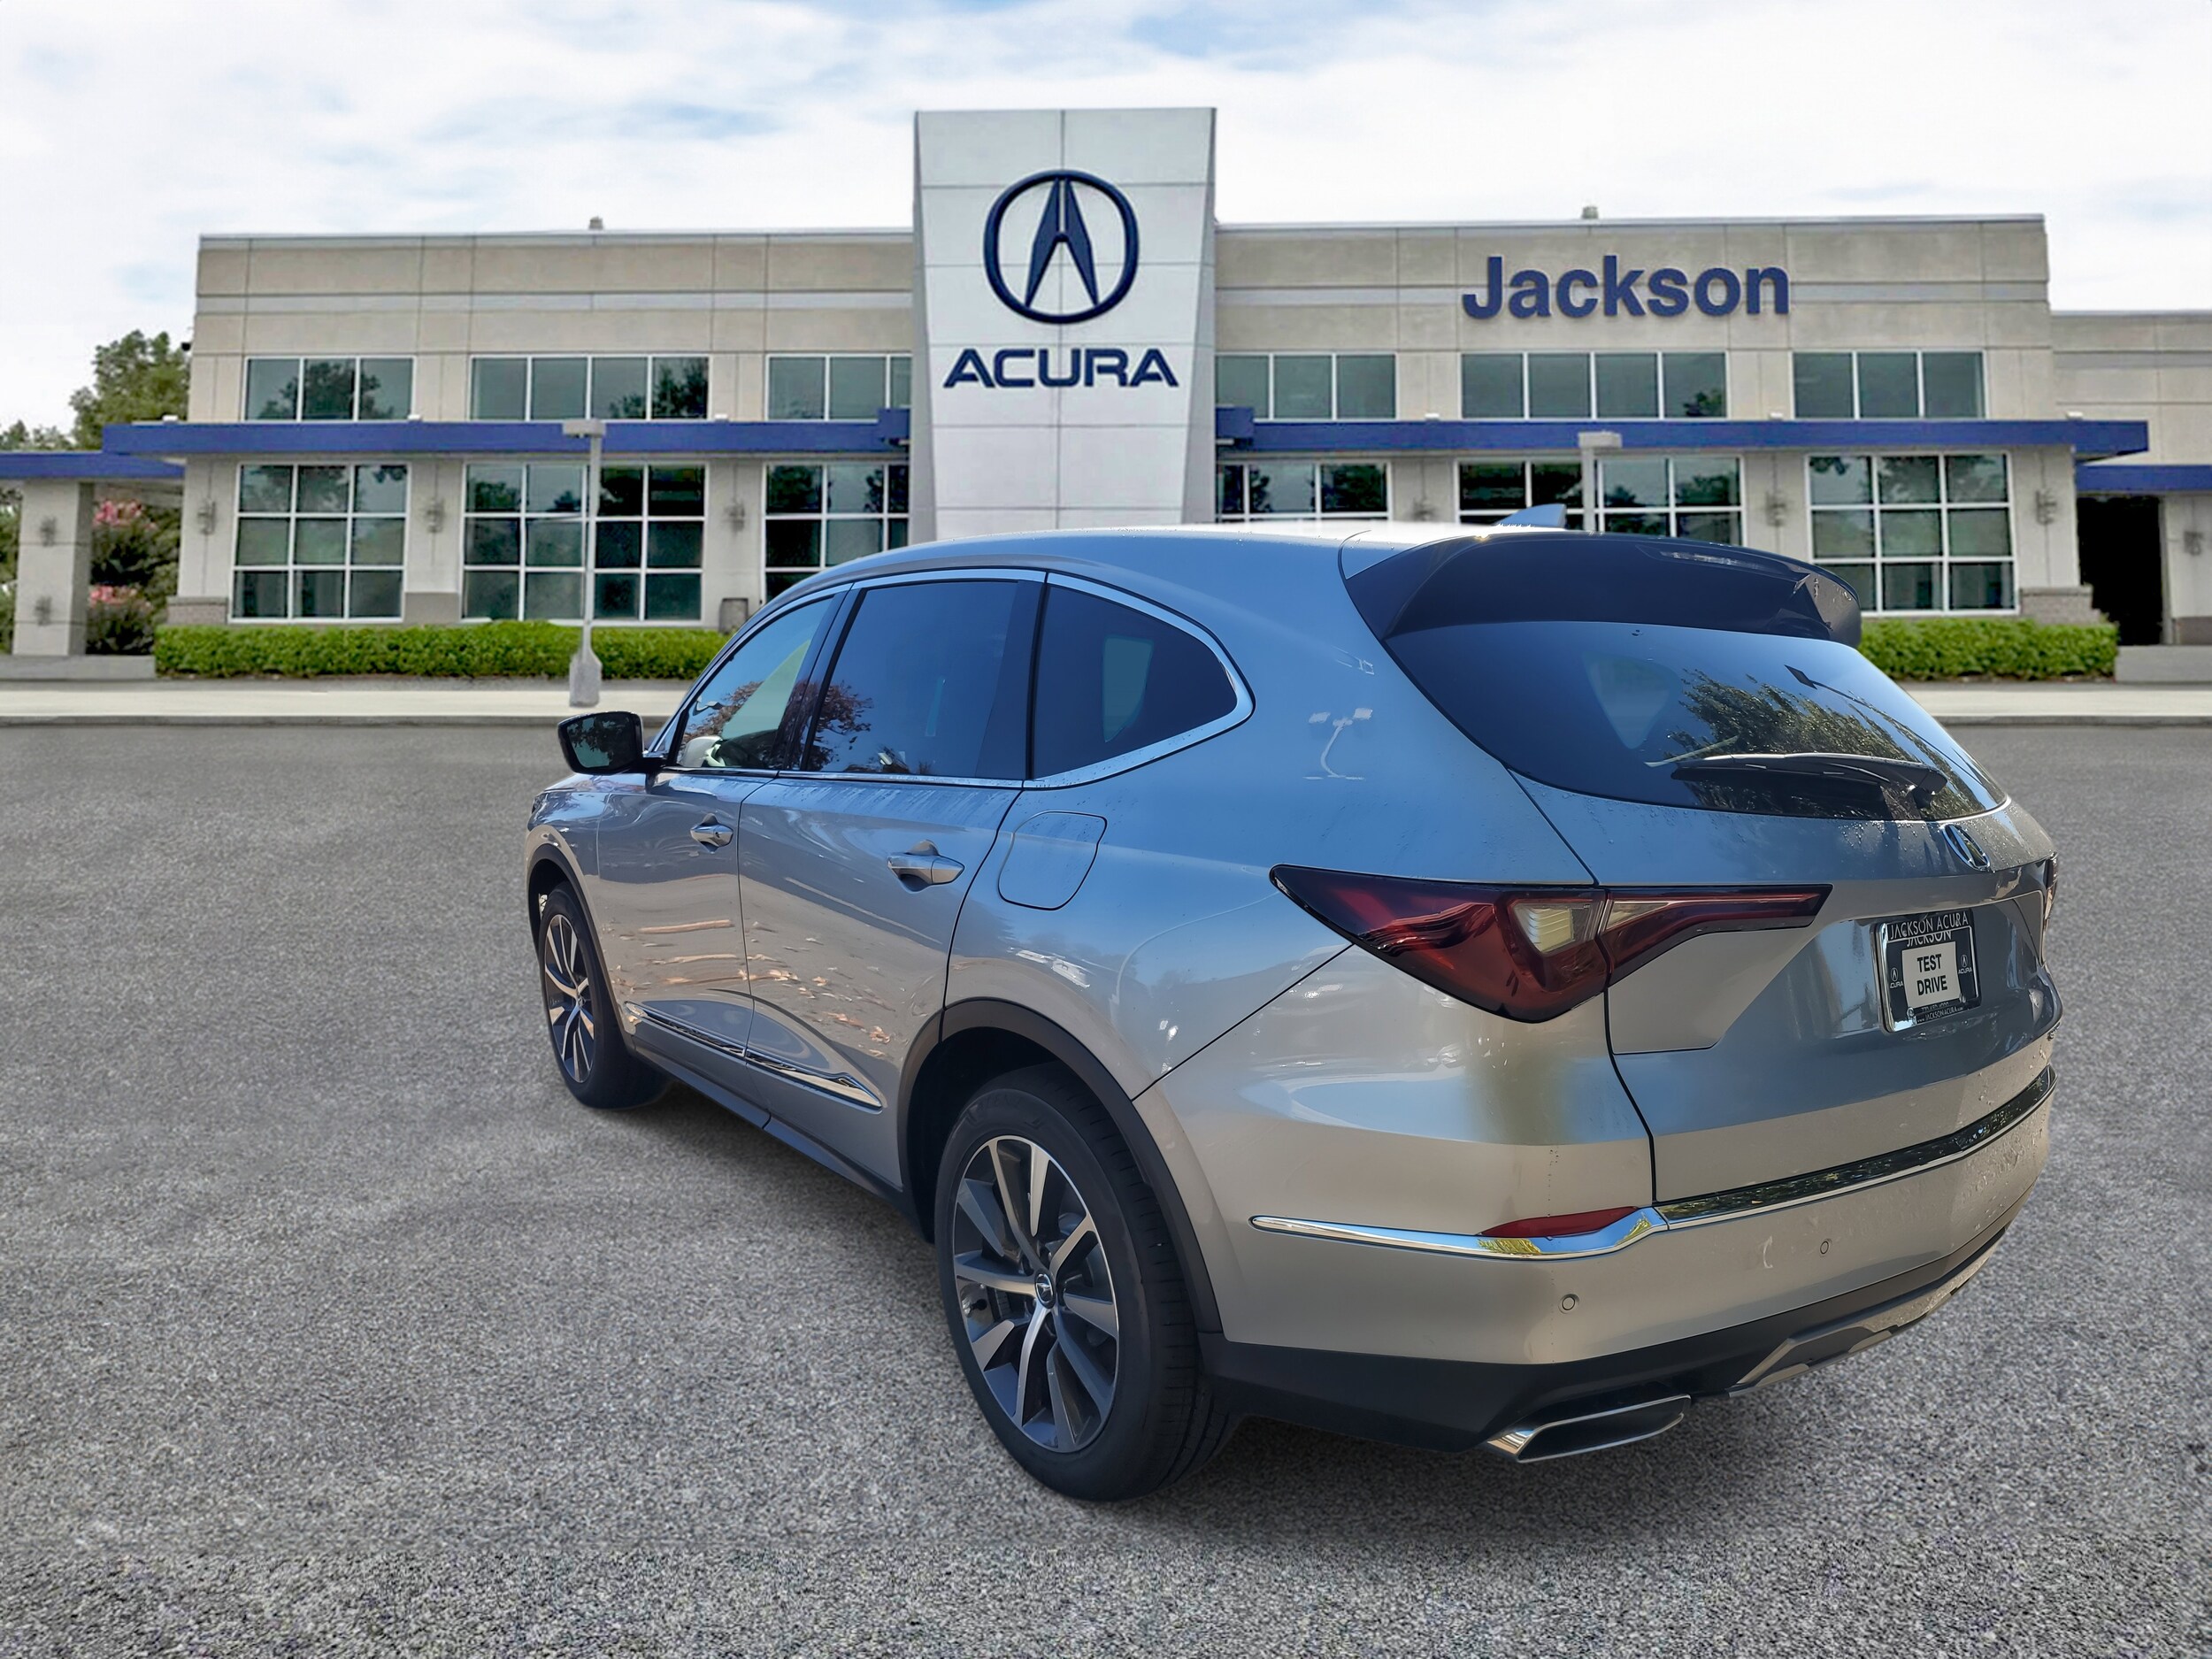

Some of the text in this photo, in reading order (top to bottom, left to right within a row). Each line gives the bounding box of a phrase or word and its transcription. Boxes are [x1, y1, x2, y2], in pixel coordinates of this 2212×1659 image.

[1463, 255, 1789, 319] Jackson
[943, 348, 1179, 388] ACURA
[1890, 910, 1969, 940] JACKSON ACURA
[1916, 953, 1942, 972] TEST
[1916, 974, 1948, 996] DRIVE
